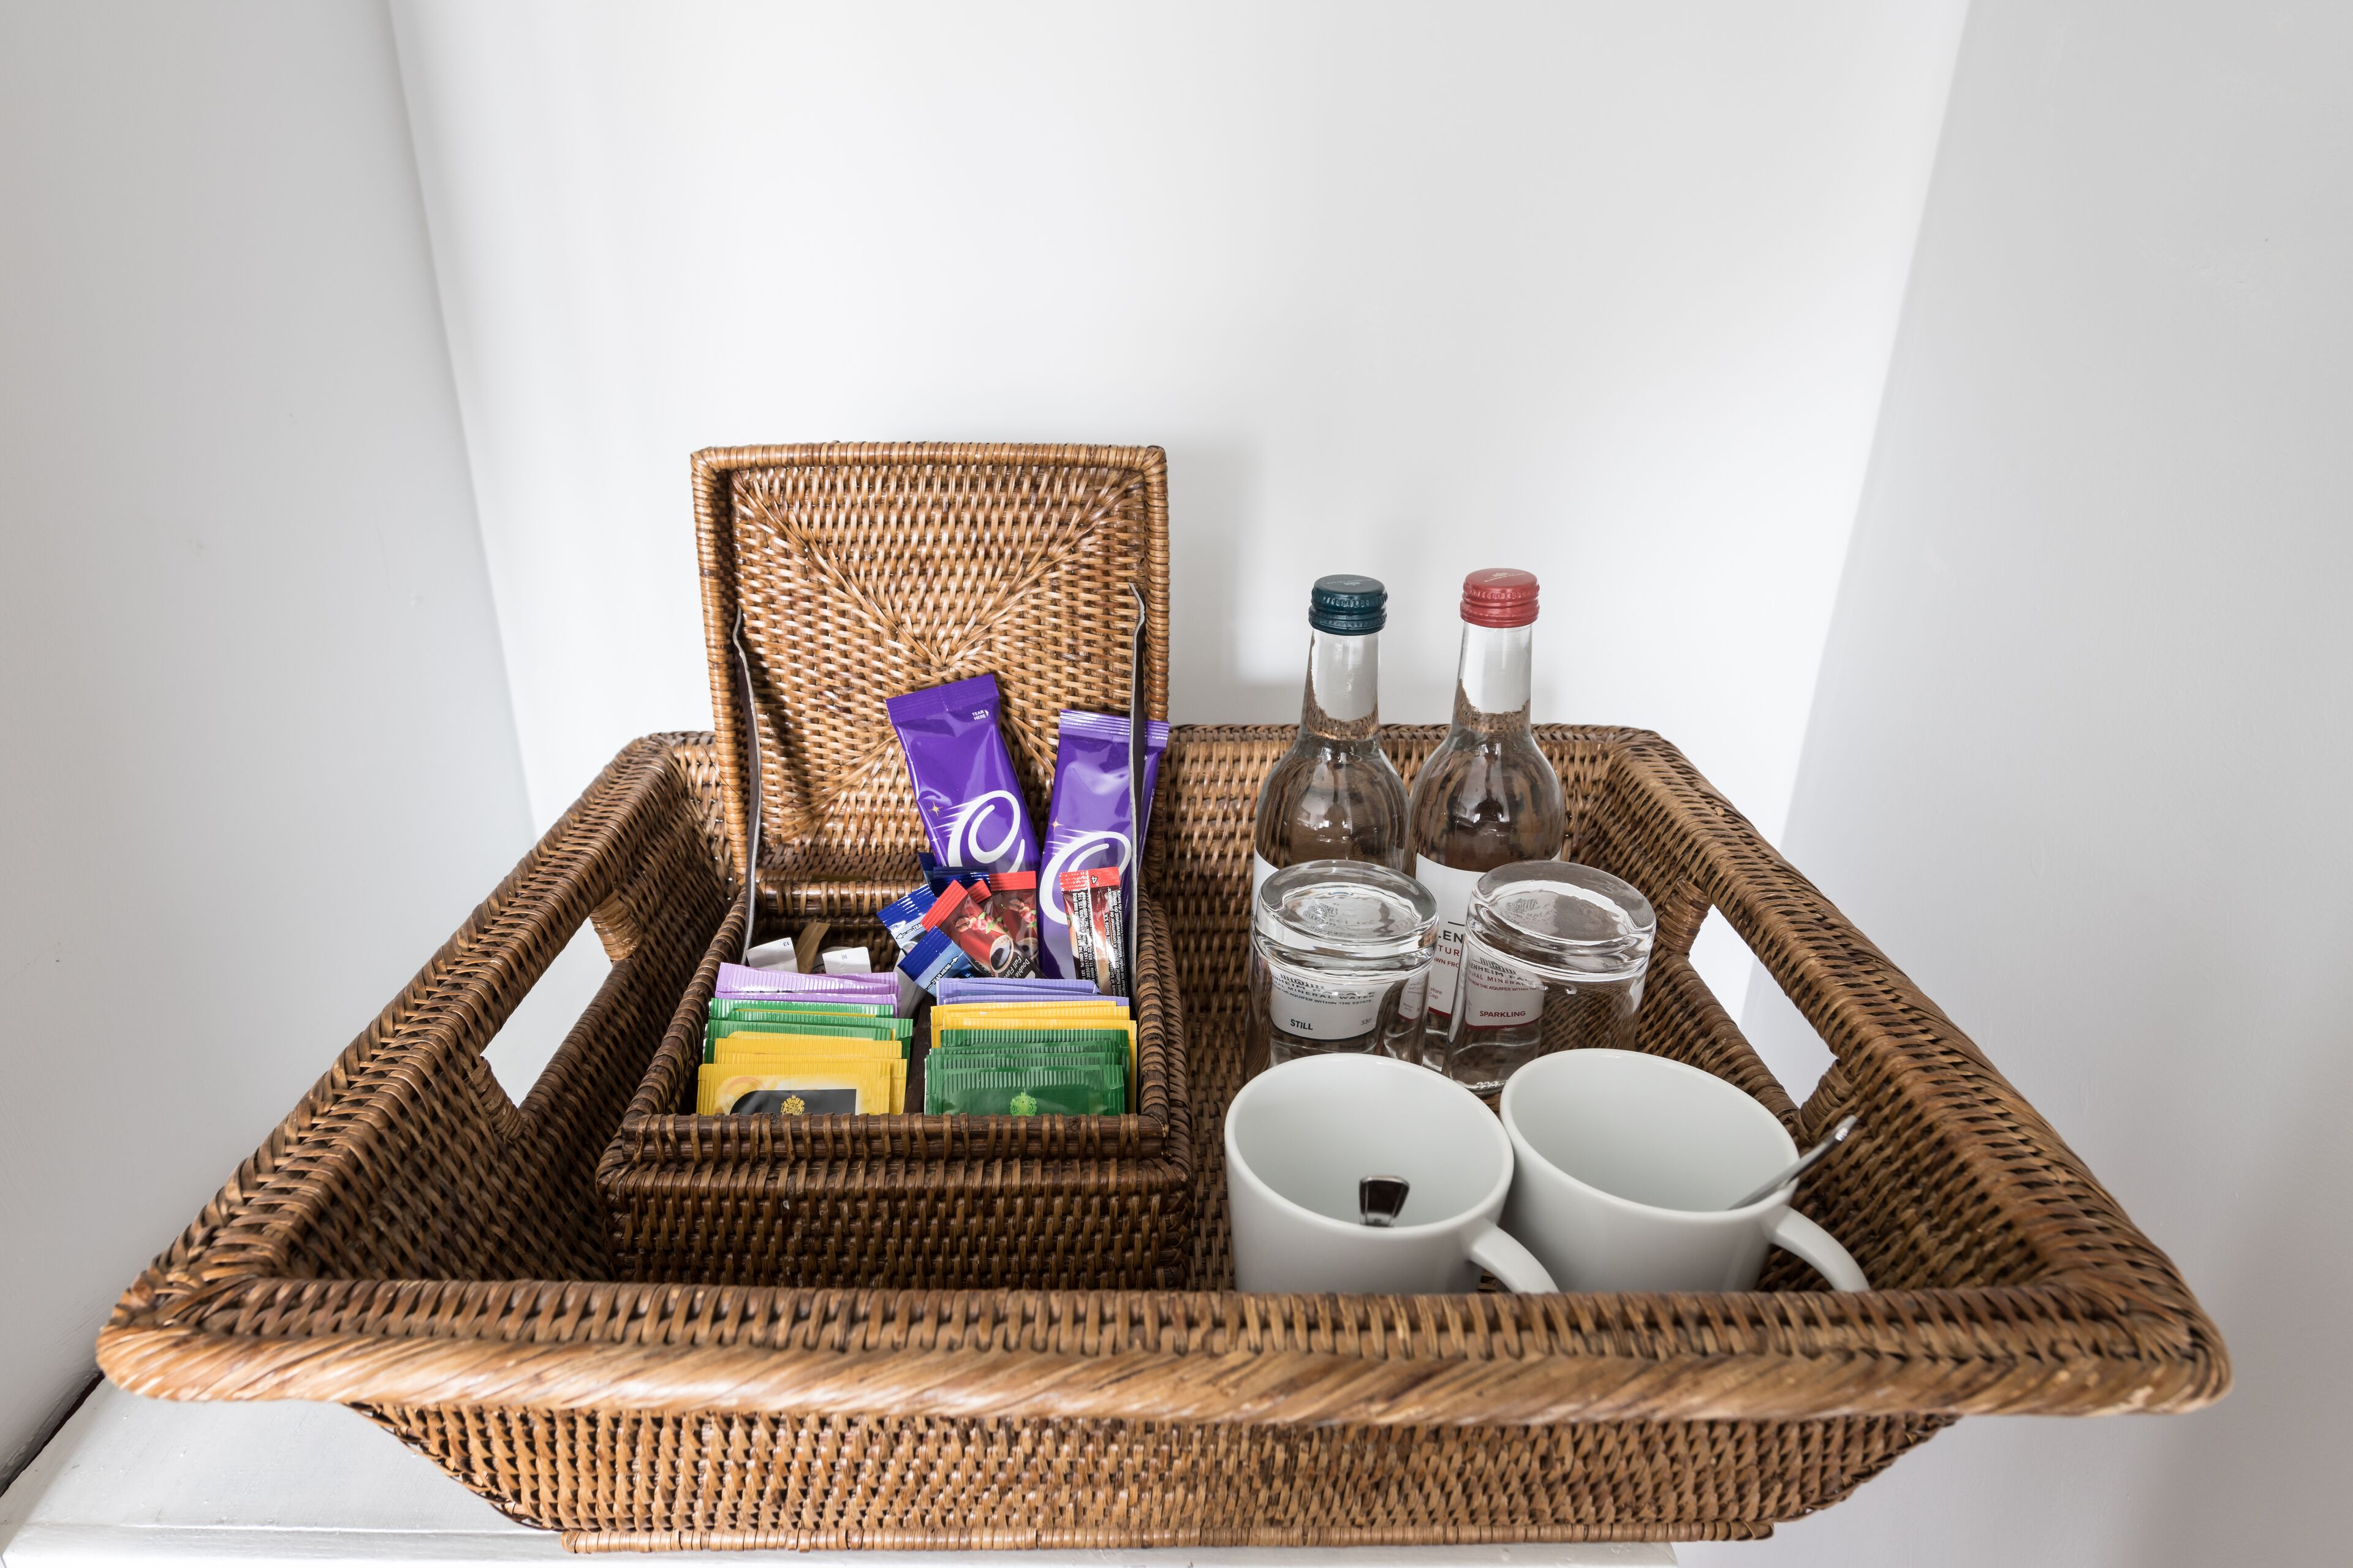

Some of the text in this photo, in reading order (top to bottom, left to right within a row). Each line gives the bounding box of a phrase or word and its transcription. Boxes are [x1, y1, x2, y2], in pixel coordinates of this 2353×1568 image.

[1438, 944, 1460, 956] TUR
[1004, 956, 1022, 978] Full Flavo
[1015, 958, 1029, 977] Double
[1434, 956, 1459, 968] AWN FRO
[941, 964, 952, 974] HERE
[1471, 963, 1504, 977] ENHEIM
[1273, 975, 1306, 990] ENHEIM
[1487, 976, 1525, 986] MINERAL
[1287, 987, 1333, 999] MINERAL
[1289, 993, 1313, 1002] AQUIFER
[1290, 1018, 1313, 1031] STILL
